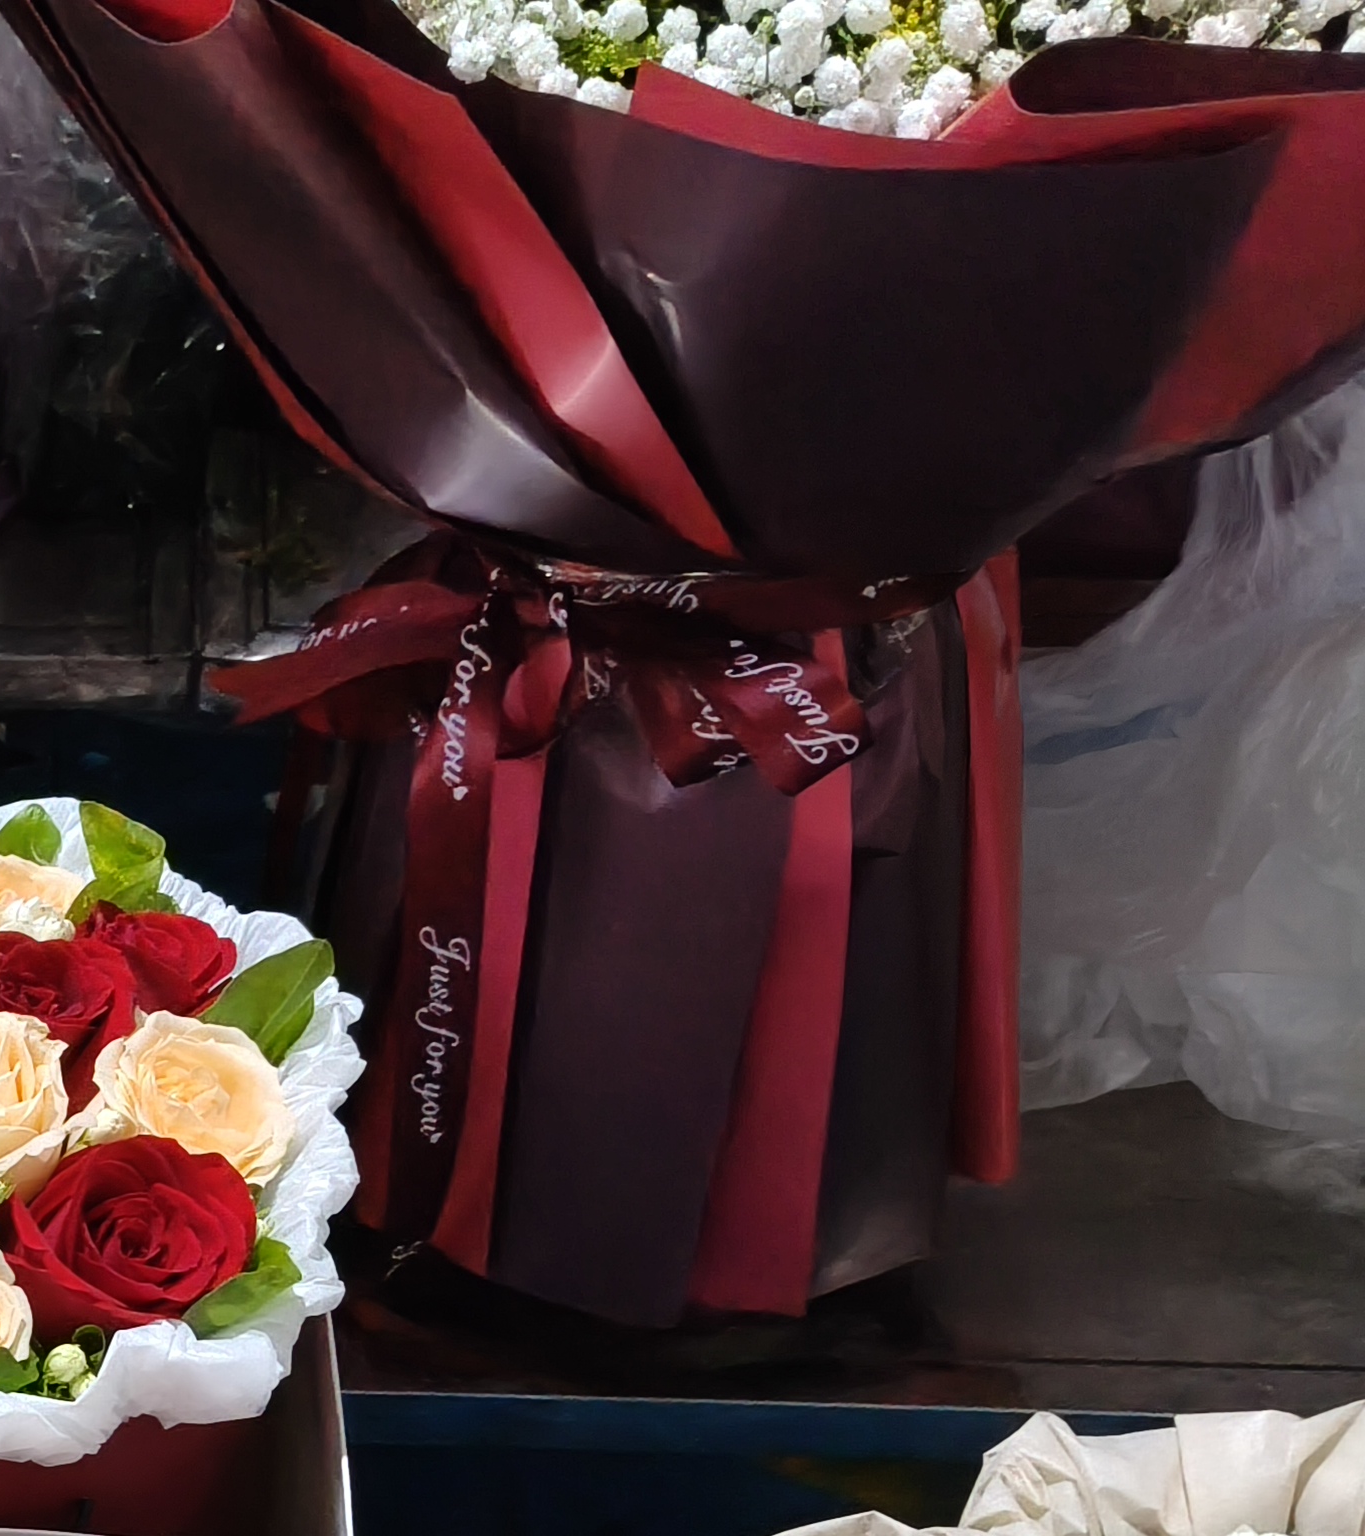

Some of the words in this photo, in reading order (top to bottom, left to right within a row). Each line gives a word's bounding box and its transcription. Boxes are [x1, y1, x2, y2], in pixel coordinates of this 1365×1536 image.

[724, 652, 804, 680] fo
[418, 925, 471, 1017] Just
[414, 1006, 461, 1076] for
[410, 1073, 442, 1138] you
